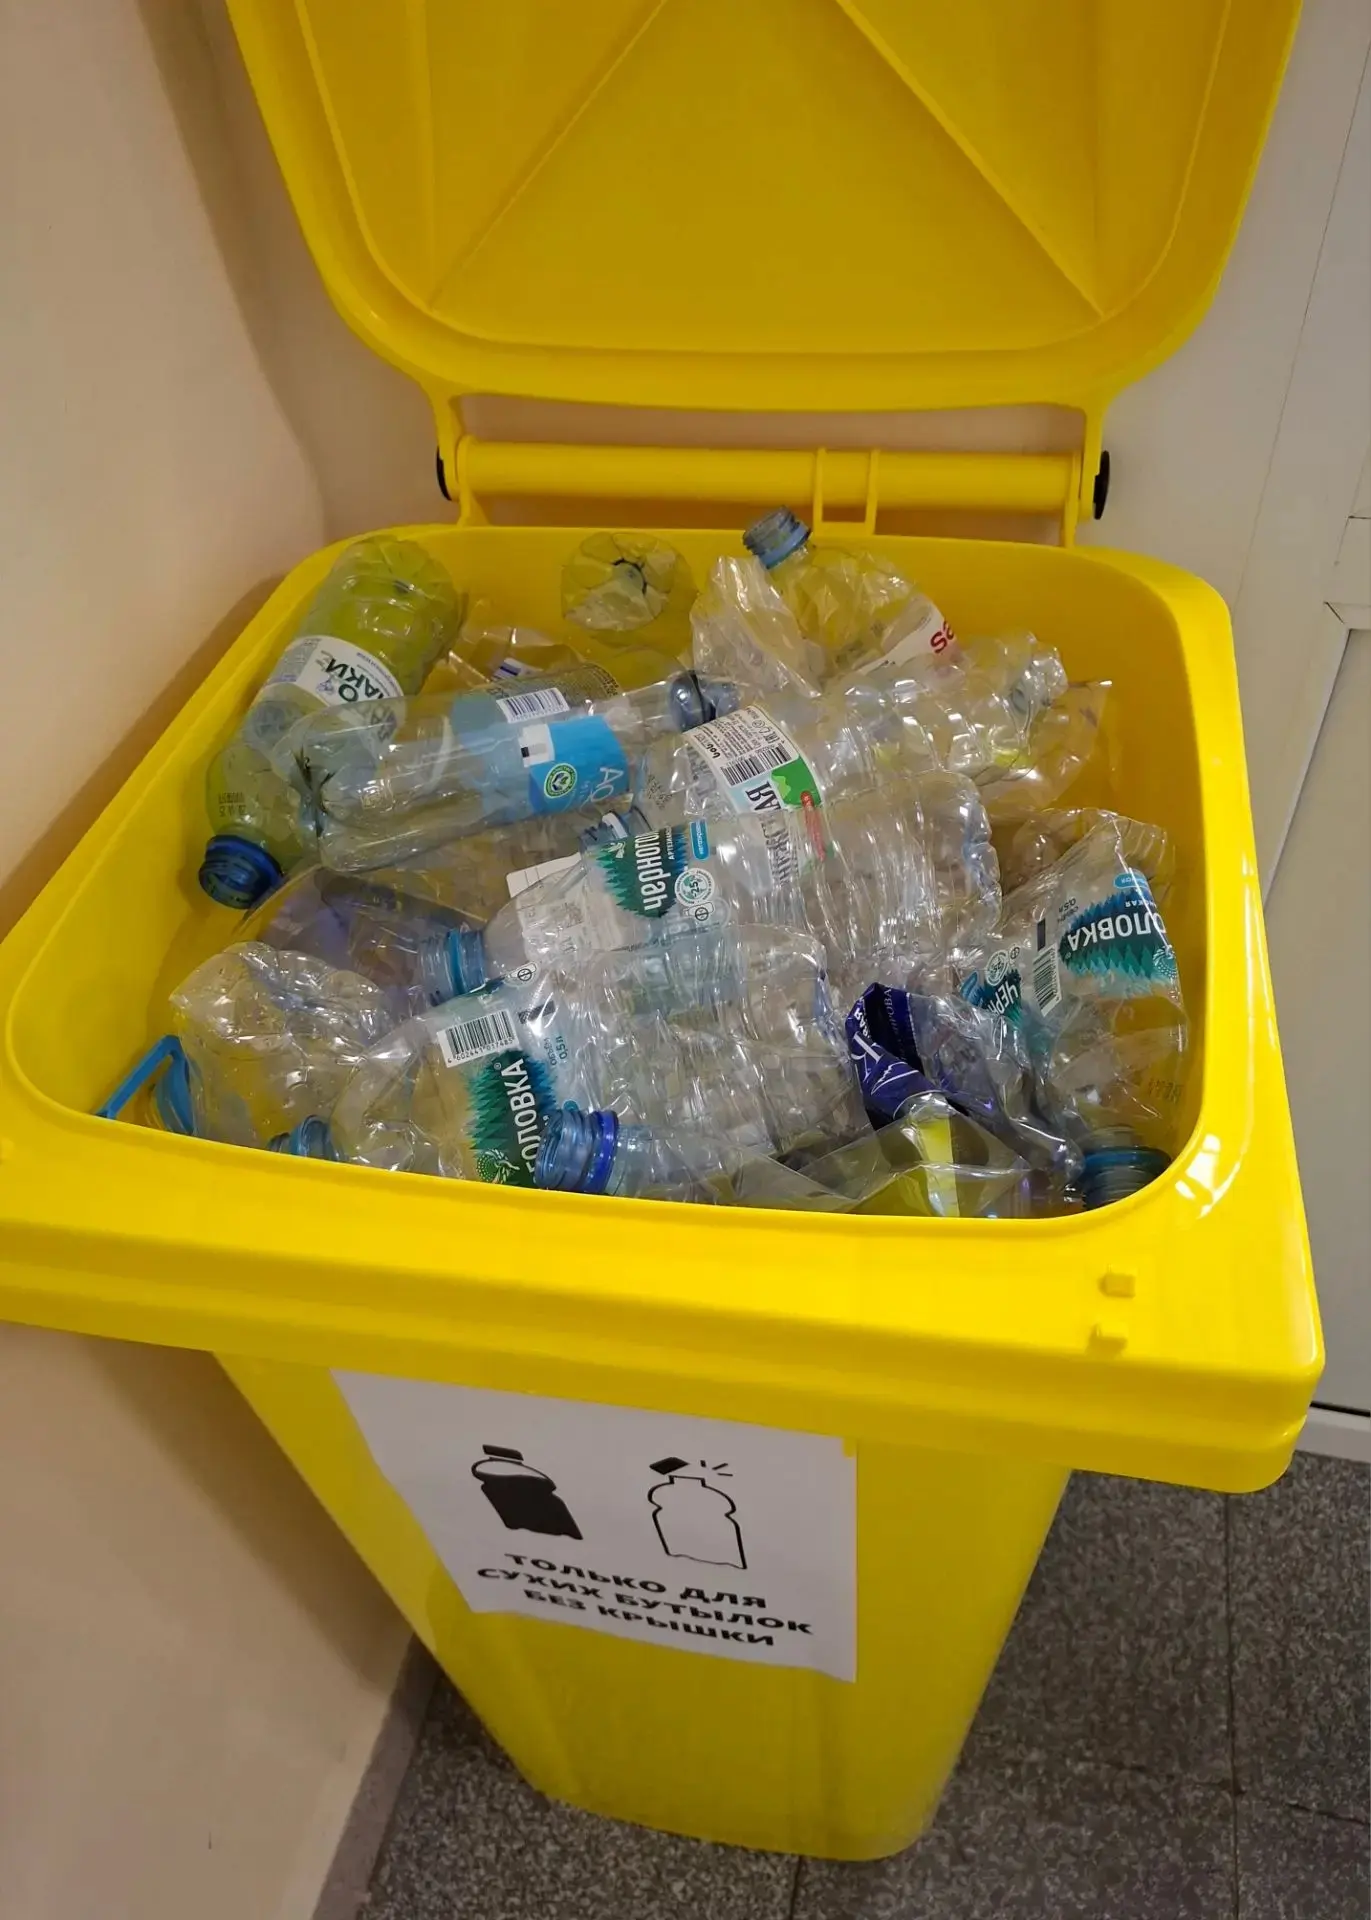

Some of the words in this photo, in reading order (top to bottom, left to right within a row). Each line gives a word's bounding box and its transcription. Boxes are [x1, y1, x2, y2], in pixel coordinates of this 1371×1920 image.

[476, 1567, 604, 1600] СУХИХ
[614, 1592, 815, 1636] БУТЫЛОК
[503, 1552, 667, 1594] ТОЛЬКО
[679, 1586, 767, 1609] ДЛЯ
[523, 1588, 587, 1611] БЕЗ
[597, 1604, 775, 1647] КРЫШКИ
